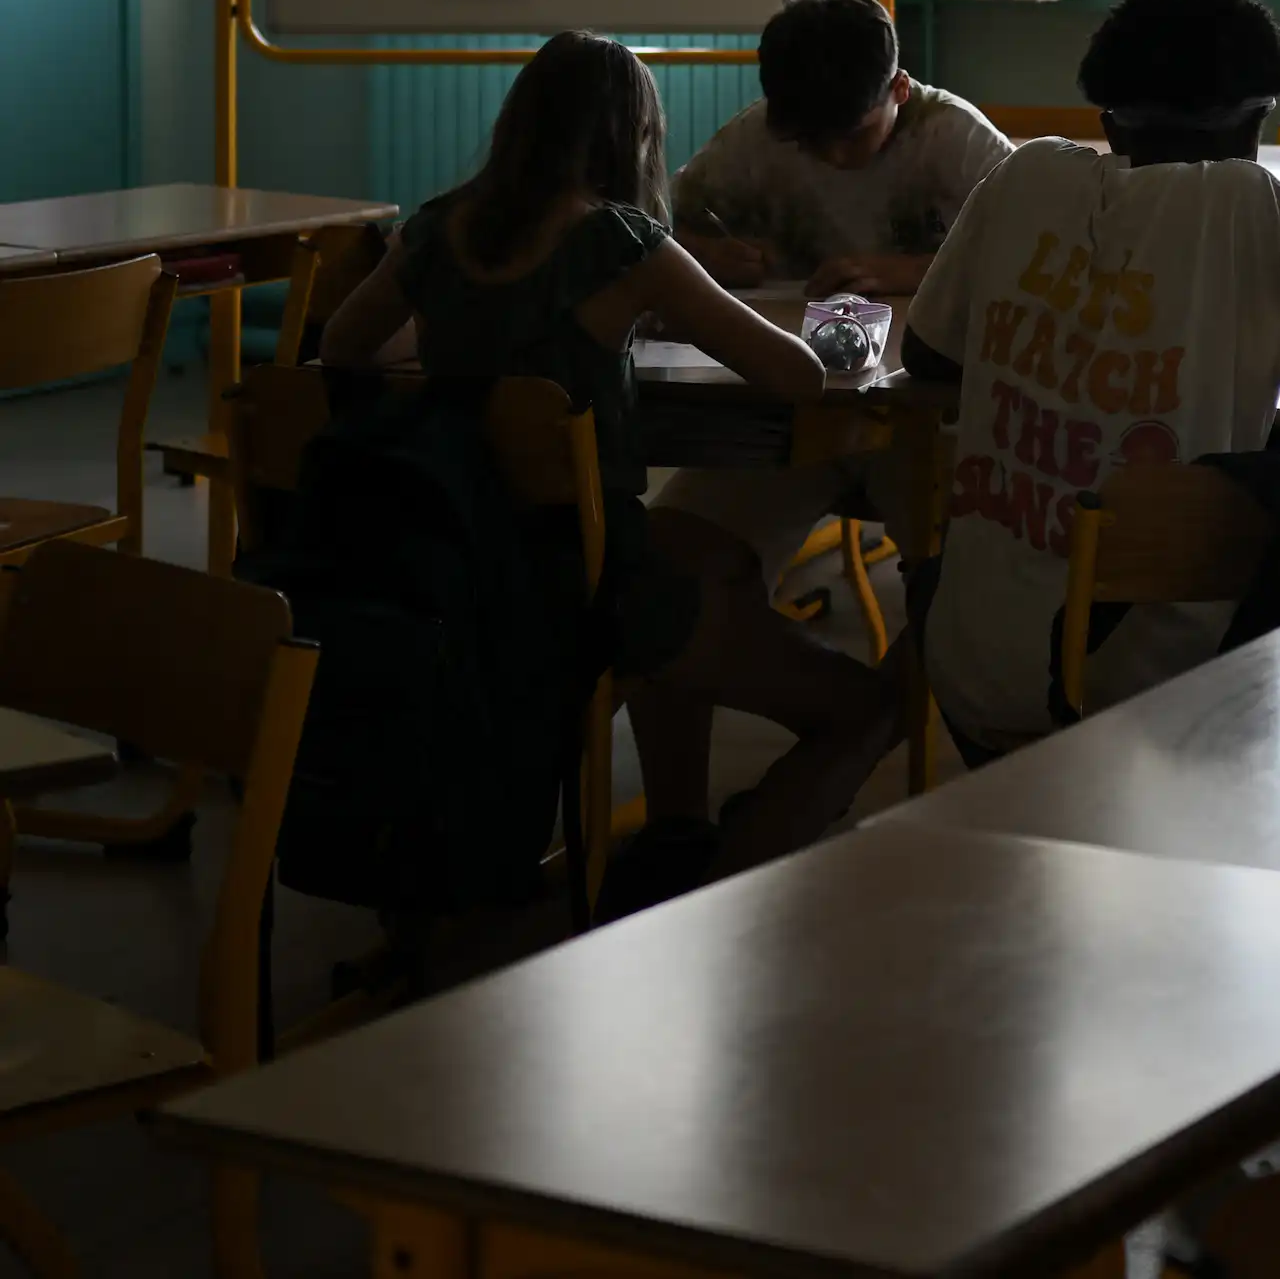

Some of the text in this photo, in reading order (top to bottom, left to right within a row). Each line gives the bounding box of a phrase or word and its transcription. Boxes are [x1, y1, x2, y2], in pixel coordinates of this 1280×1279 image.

[1018, 231, 1155, 337] LET'S
[980, 300, 1185, 415] WATCH
[990, 380, 1103, 487] THE
